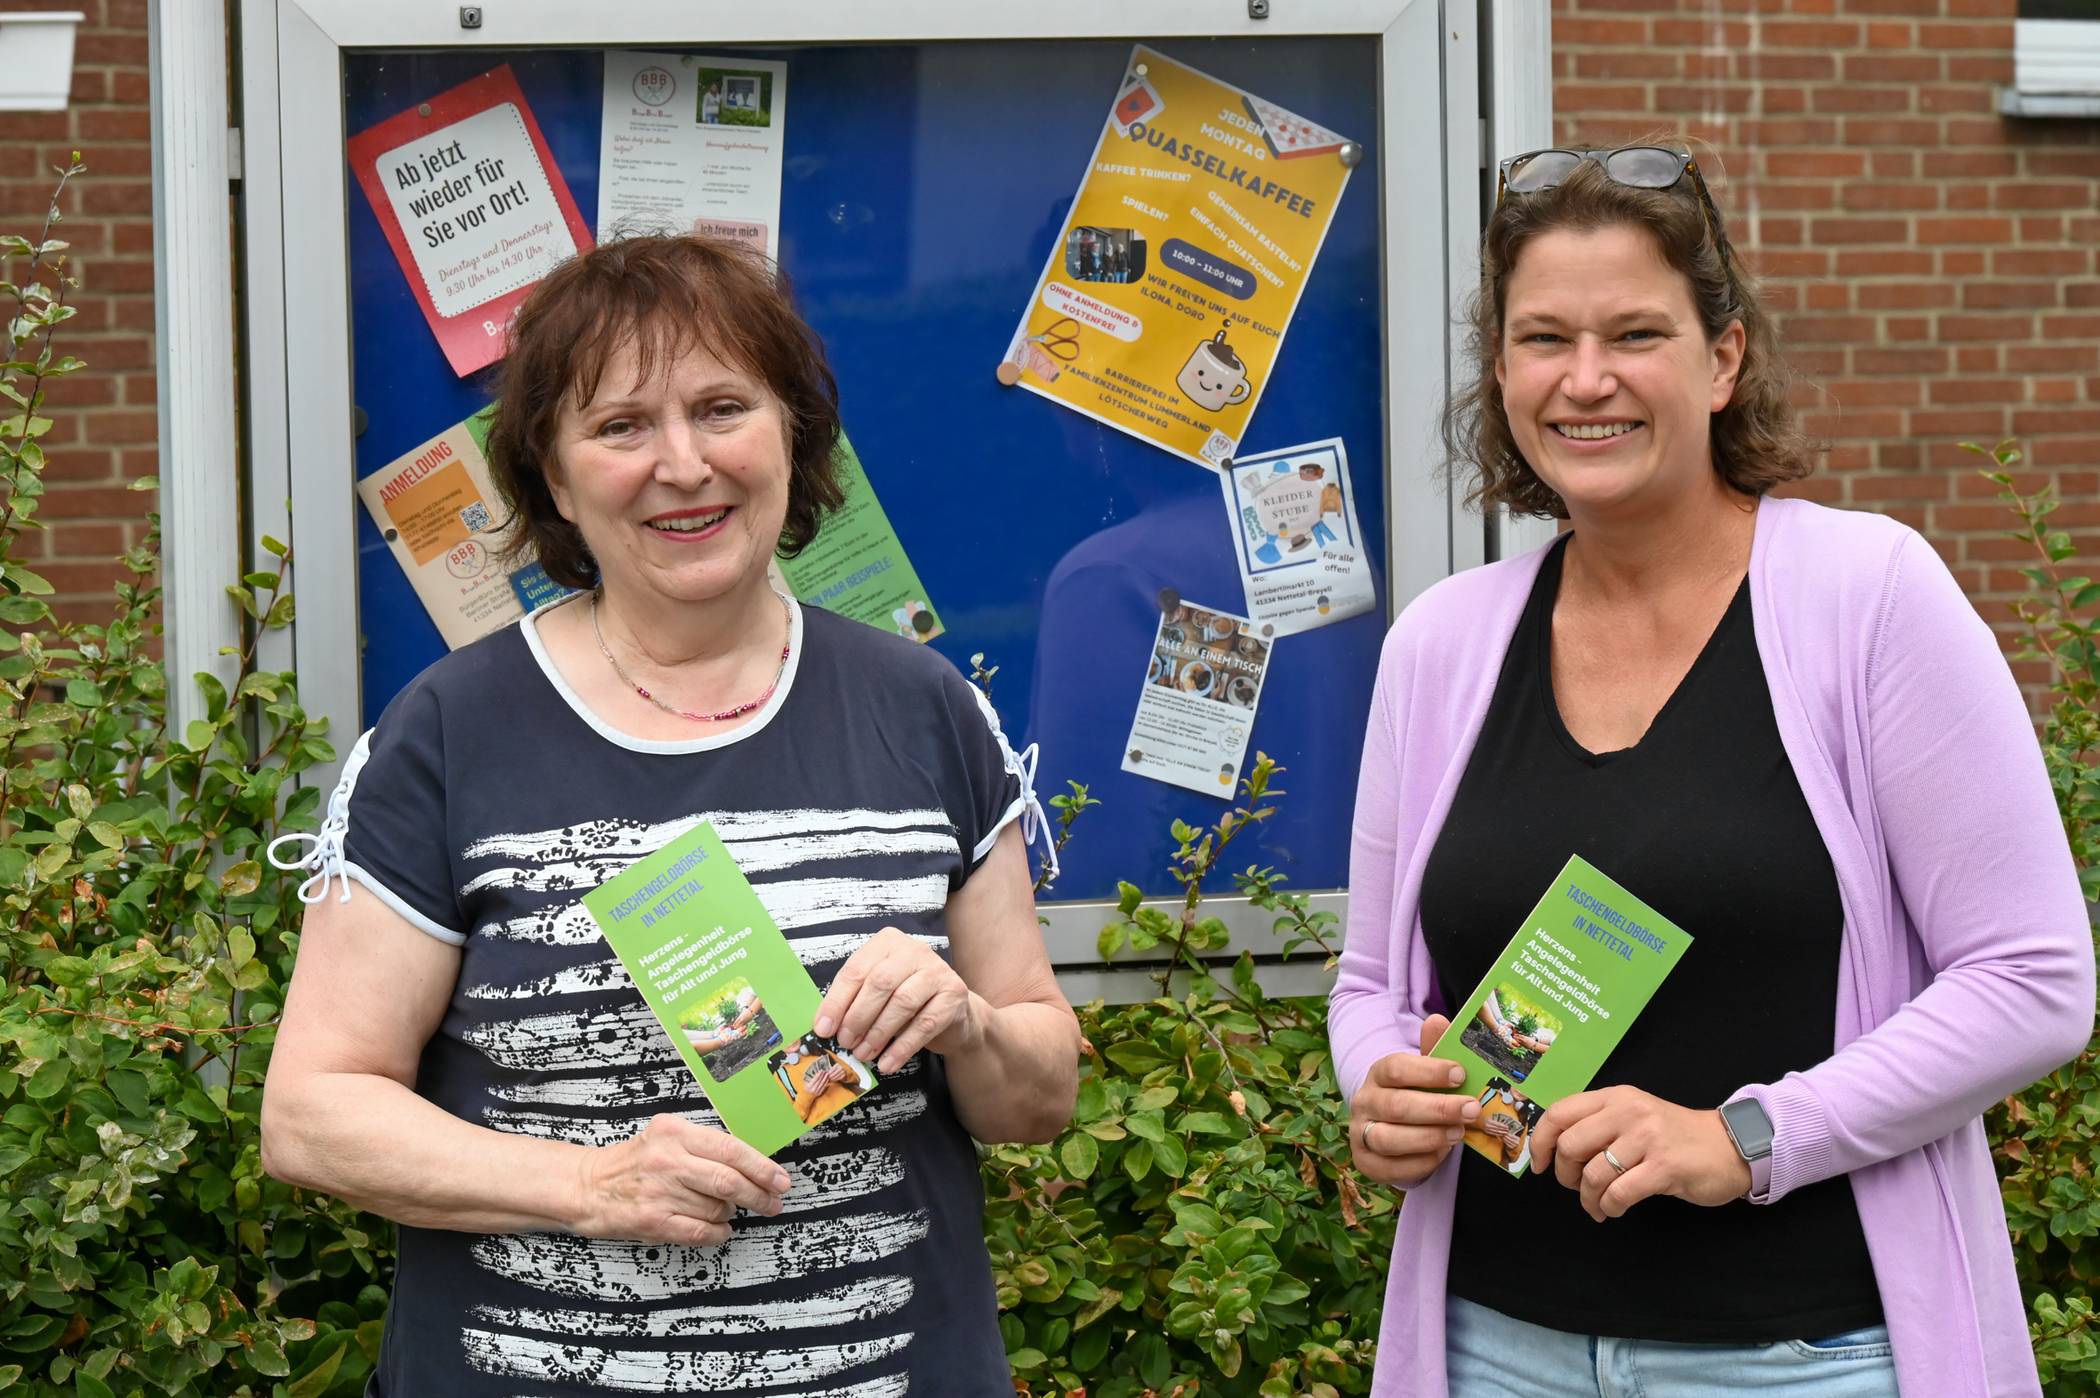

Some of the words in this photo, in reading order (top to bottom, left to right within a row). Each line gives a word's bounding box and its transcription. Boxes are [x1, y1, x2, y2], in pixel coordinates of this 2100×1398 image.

[641, 74, 666, 85] BBB
[1200, 122, 1265, 160] MONTAG
[1218, 109, 1265, 137] JEDEN
[395, 162, 420, 189] Ab
[419, 139, 467, 182] jetzt
[1096, 162, 1137, 176] KAFFEE
[1140, 167, 1191, 182] TRINKEN?
[1128, 122, 1316, 219] QUASSELKAFFEE
[409, 173, 473, 219] wieder
[475, 157, 504, 187] für
[1122, 195, 1168, 221] SPIELEN?
[422, 220, 455, 248] Sie
[456, 202, 487, 230] vor
[489, 180, 529, 215] Ort!
[700, 224, 713, 235] Ich
[715, 225, 736, 238] freue
[739, 227, 758, 237] mich
[1208, 191, 1259, 238] GEMEINSAM
[1258, 232, 1302, 272] BASTELN?
[438, 254, 481, 282] Dienstags
[483, 243, 500, 260] und
[500, 220, 554, 252] Donnerstags
[467, 272, 486, 288] Uhr
[487, 262, 500, 276] bis
[525, 244, 543, 261] Uhr
[1172, 250, 1195, 266] 10:00
[1203, 264, 1225, 279] 11:00
[1226, 273, 1244, 288] UHR
[1190, 207, 1227, 240] EINFACH
[1228, 239, 1284, 288] QUATSCHEN?
[1049, 283, 1074, 301] OHNE
[1074, 295, 1130, 326] ANMELDUNG
[1131, 318, 1139, 328] &
[1061, 303, 1117, 332] KOSTENFREI
[1148, 273, 1166, 288] WIR
[1169, 283, 1207, 307] FREUEN
[1209, 298, 1228, 315] UNS
[1230, 311, 1250, 327] AUF
[1252, 321, 1280, 339] EUCH
[1176, 302, 1205, 322] DORO
[1064, 364, 1148, 405] FAMILIENZENTRUM
[1150, 400, 1211, 433] LUMMERLAND
[1105, 368, 1167, 398] BARRIEREFREI
[1168, 396, 1179, 405] IM
[379, 441, 453, 504] ANMELDUNG
[1264, 489, 1313, 506] KLEIDER
[1272, 505, 1310, 519] STUBE
[450, 543, 477, 565] BBB
[1323, 551, 1338, 560] Für
[1338, 554, 1354, 562] alle
[1325, 565, 1351, 574] offen!
[1254, 582, 1304, 597] Lambertimarkt
[1158, 639, 1182, 652] ALLE
[1184, 646, 1198, 656] AN
[1200, 649, 1232, 665] EINEM
[1234, 660, 1263, 674] TISCH
[608, 845, 709, 923] TASCHENGELDBÖRSE
[640, 915, 656, 928] IN
[653, 880, 704, 919] NETTETAL
[1566, 884, 1667, 954] TASCHENGELDBÖRSE
[1573, 915, 1585, 929] IN
[1585, 923, 1634, 961] NETTETAL
[639, 936, 683, 967] Herzens
[647, 925, 726, 980] Angelegenheit
[654, 927, 753, 991] Taschengeldbörse
[1527, 939, 1601, 996] Angelegenheit
[1535, 928, 1576, 962] Herzens
[662, 990, 679, 1005] für
[680, 979, 697, 994] Alt
[697, 966, 718, 985] und
[719, 947, 748, 969] Jung
[1511, 961, 1527, 979] für
[1526, 971, 1543, 990] Alt
[1542, 985, 1562, 1003] und
[1562, 1000, 1590, 1023] Jung
[1520, 949, 1610, 1019] Taschengeldbörse
